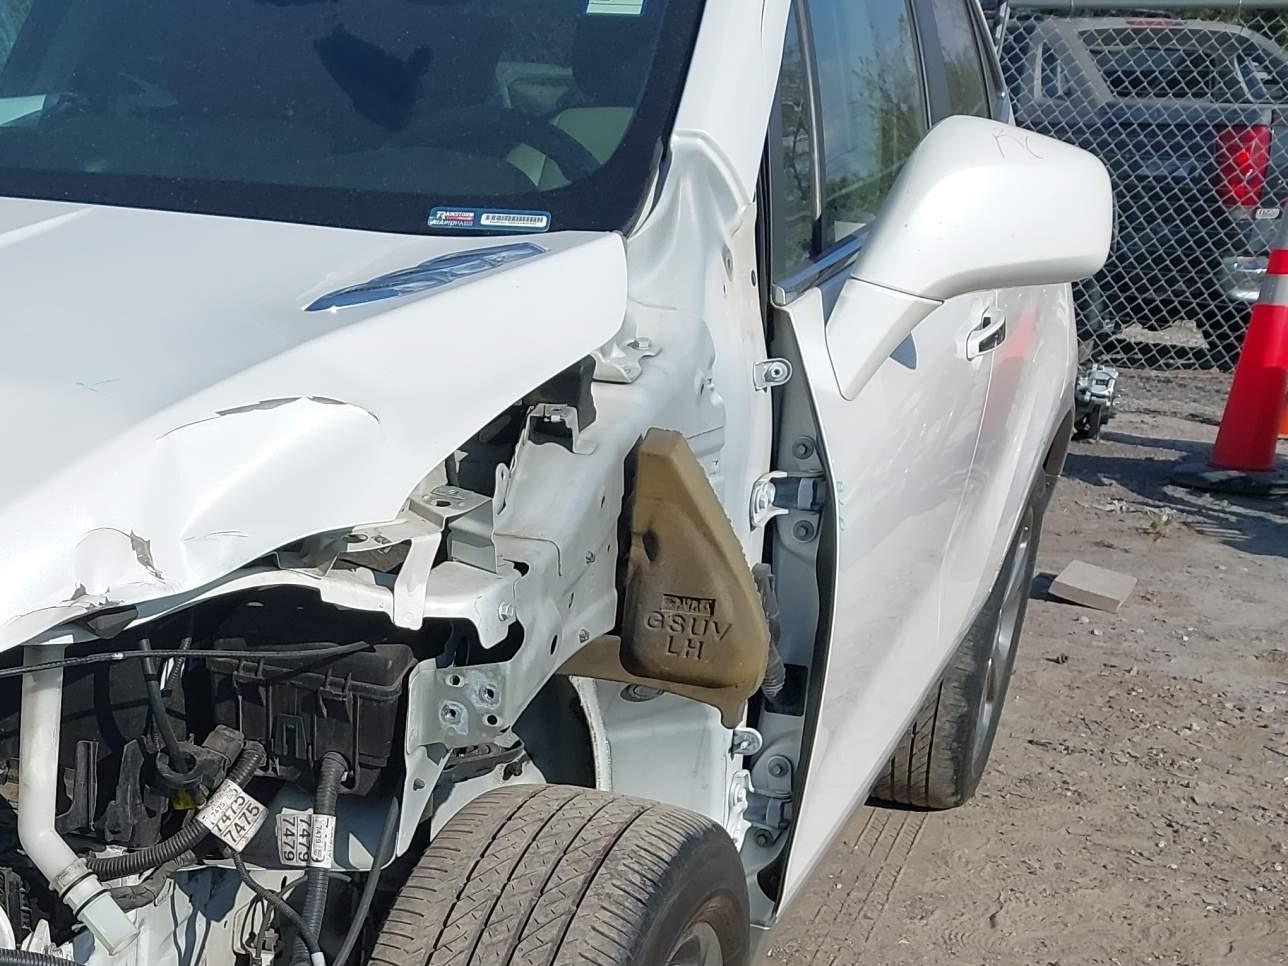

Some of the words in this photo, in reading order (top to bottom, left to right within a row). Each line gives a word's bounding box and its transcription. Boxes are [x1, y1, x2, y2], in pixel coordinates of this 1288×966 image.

[646, 610, 734, 643] GSUV
[666, 636, 706, 661] LH
[223, 803, 261, 843] 7475
[283, 816, 296, 862] 7479
[299, 816, 312, 863] 7479
